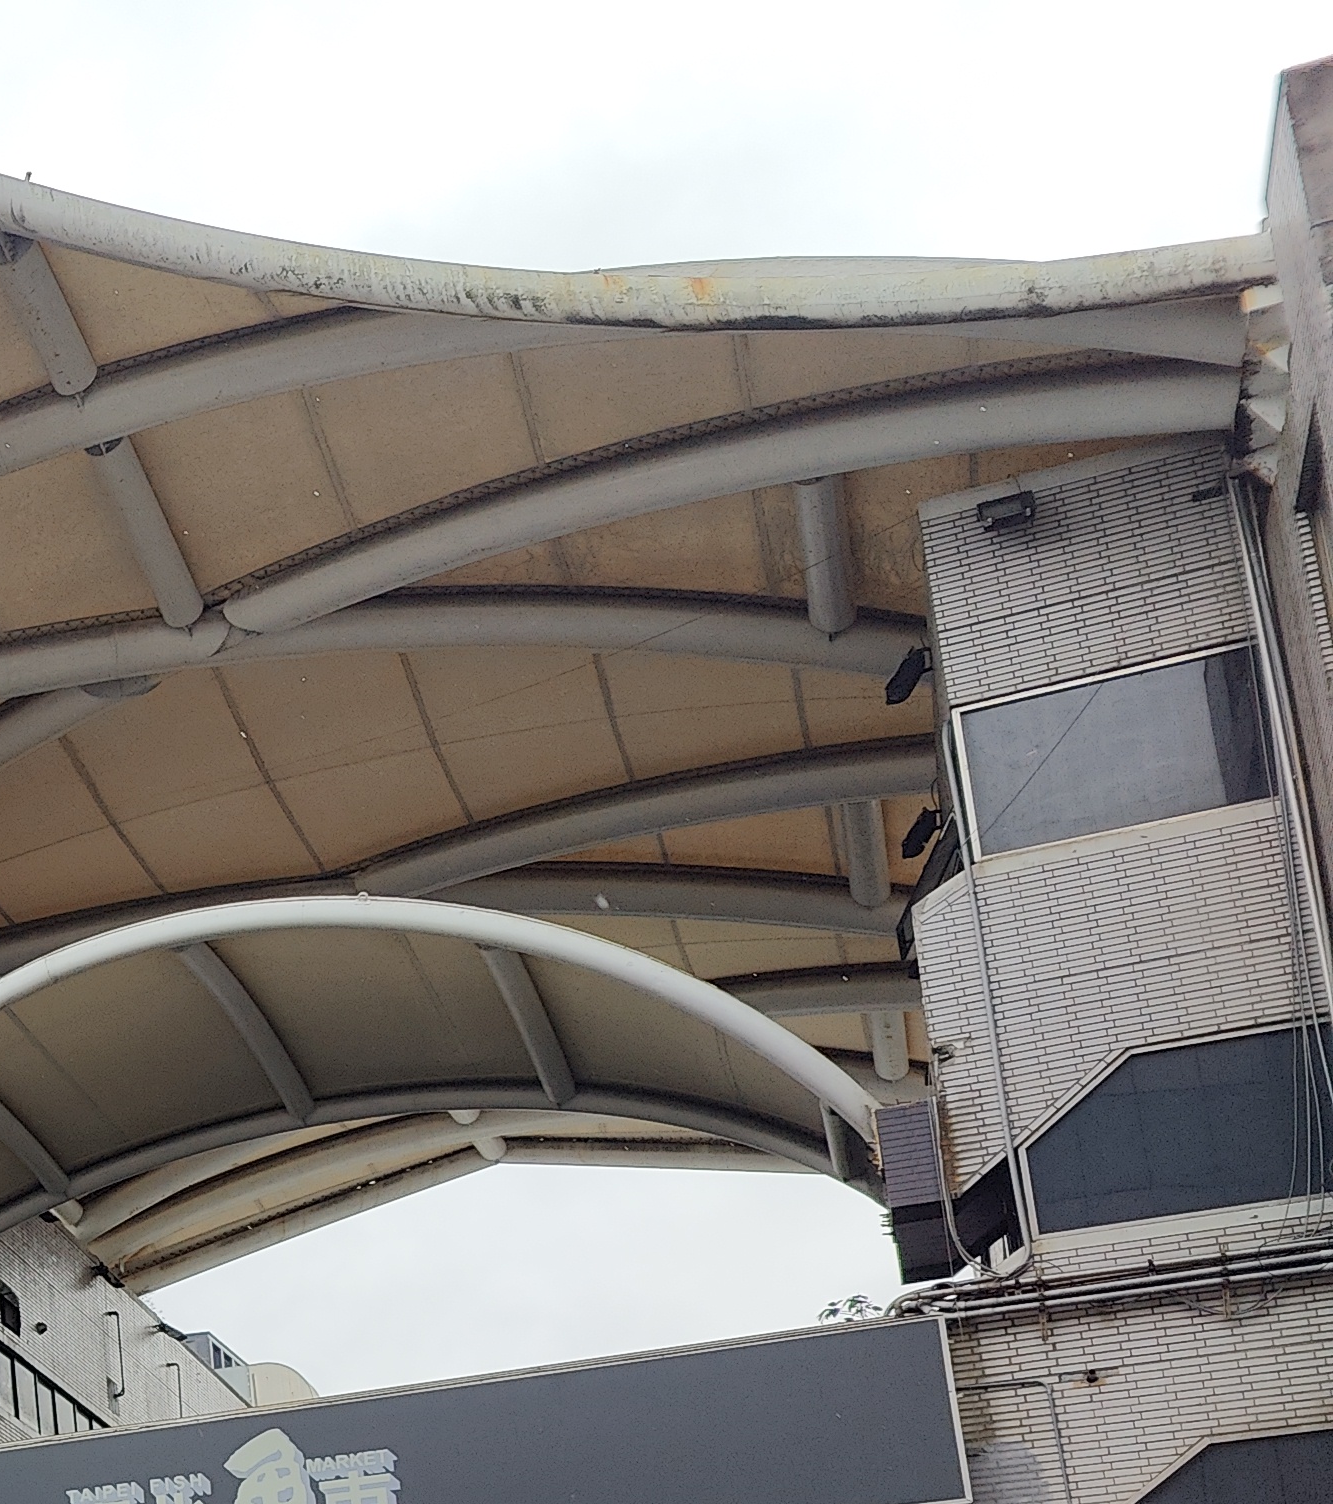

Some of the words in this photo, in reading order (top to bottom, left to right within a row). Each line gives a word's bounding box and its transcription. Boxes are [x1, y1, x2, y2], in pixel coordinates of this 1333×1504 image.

[66, 1481, 145, 1504] TAIPEI
[149, 1472, 212, 1496] FISH
[305, 1449, 398, 1479] MARKET
